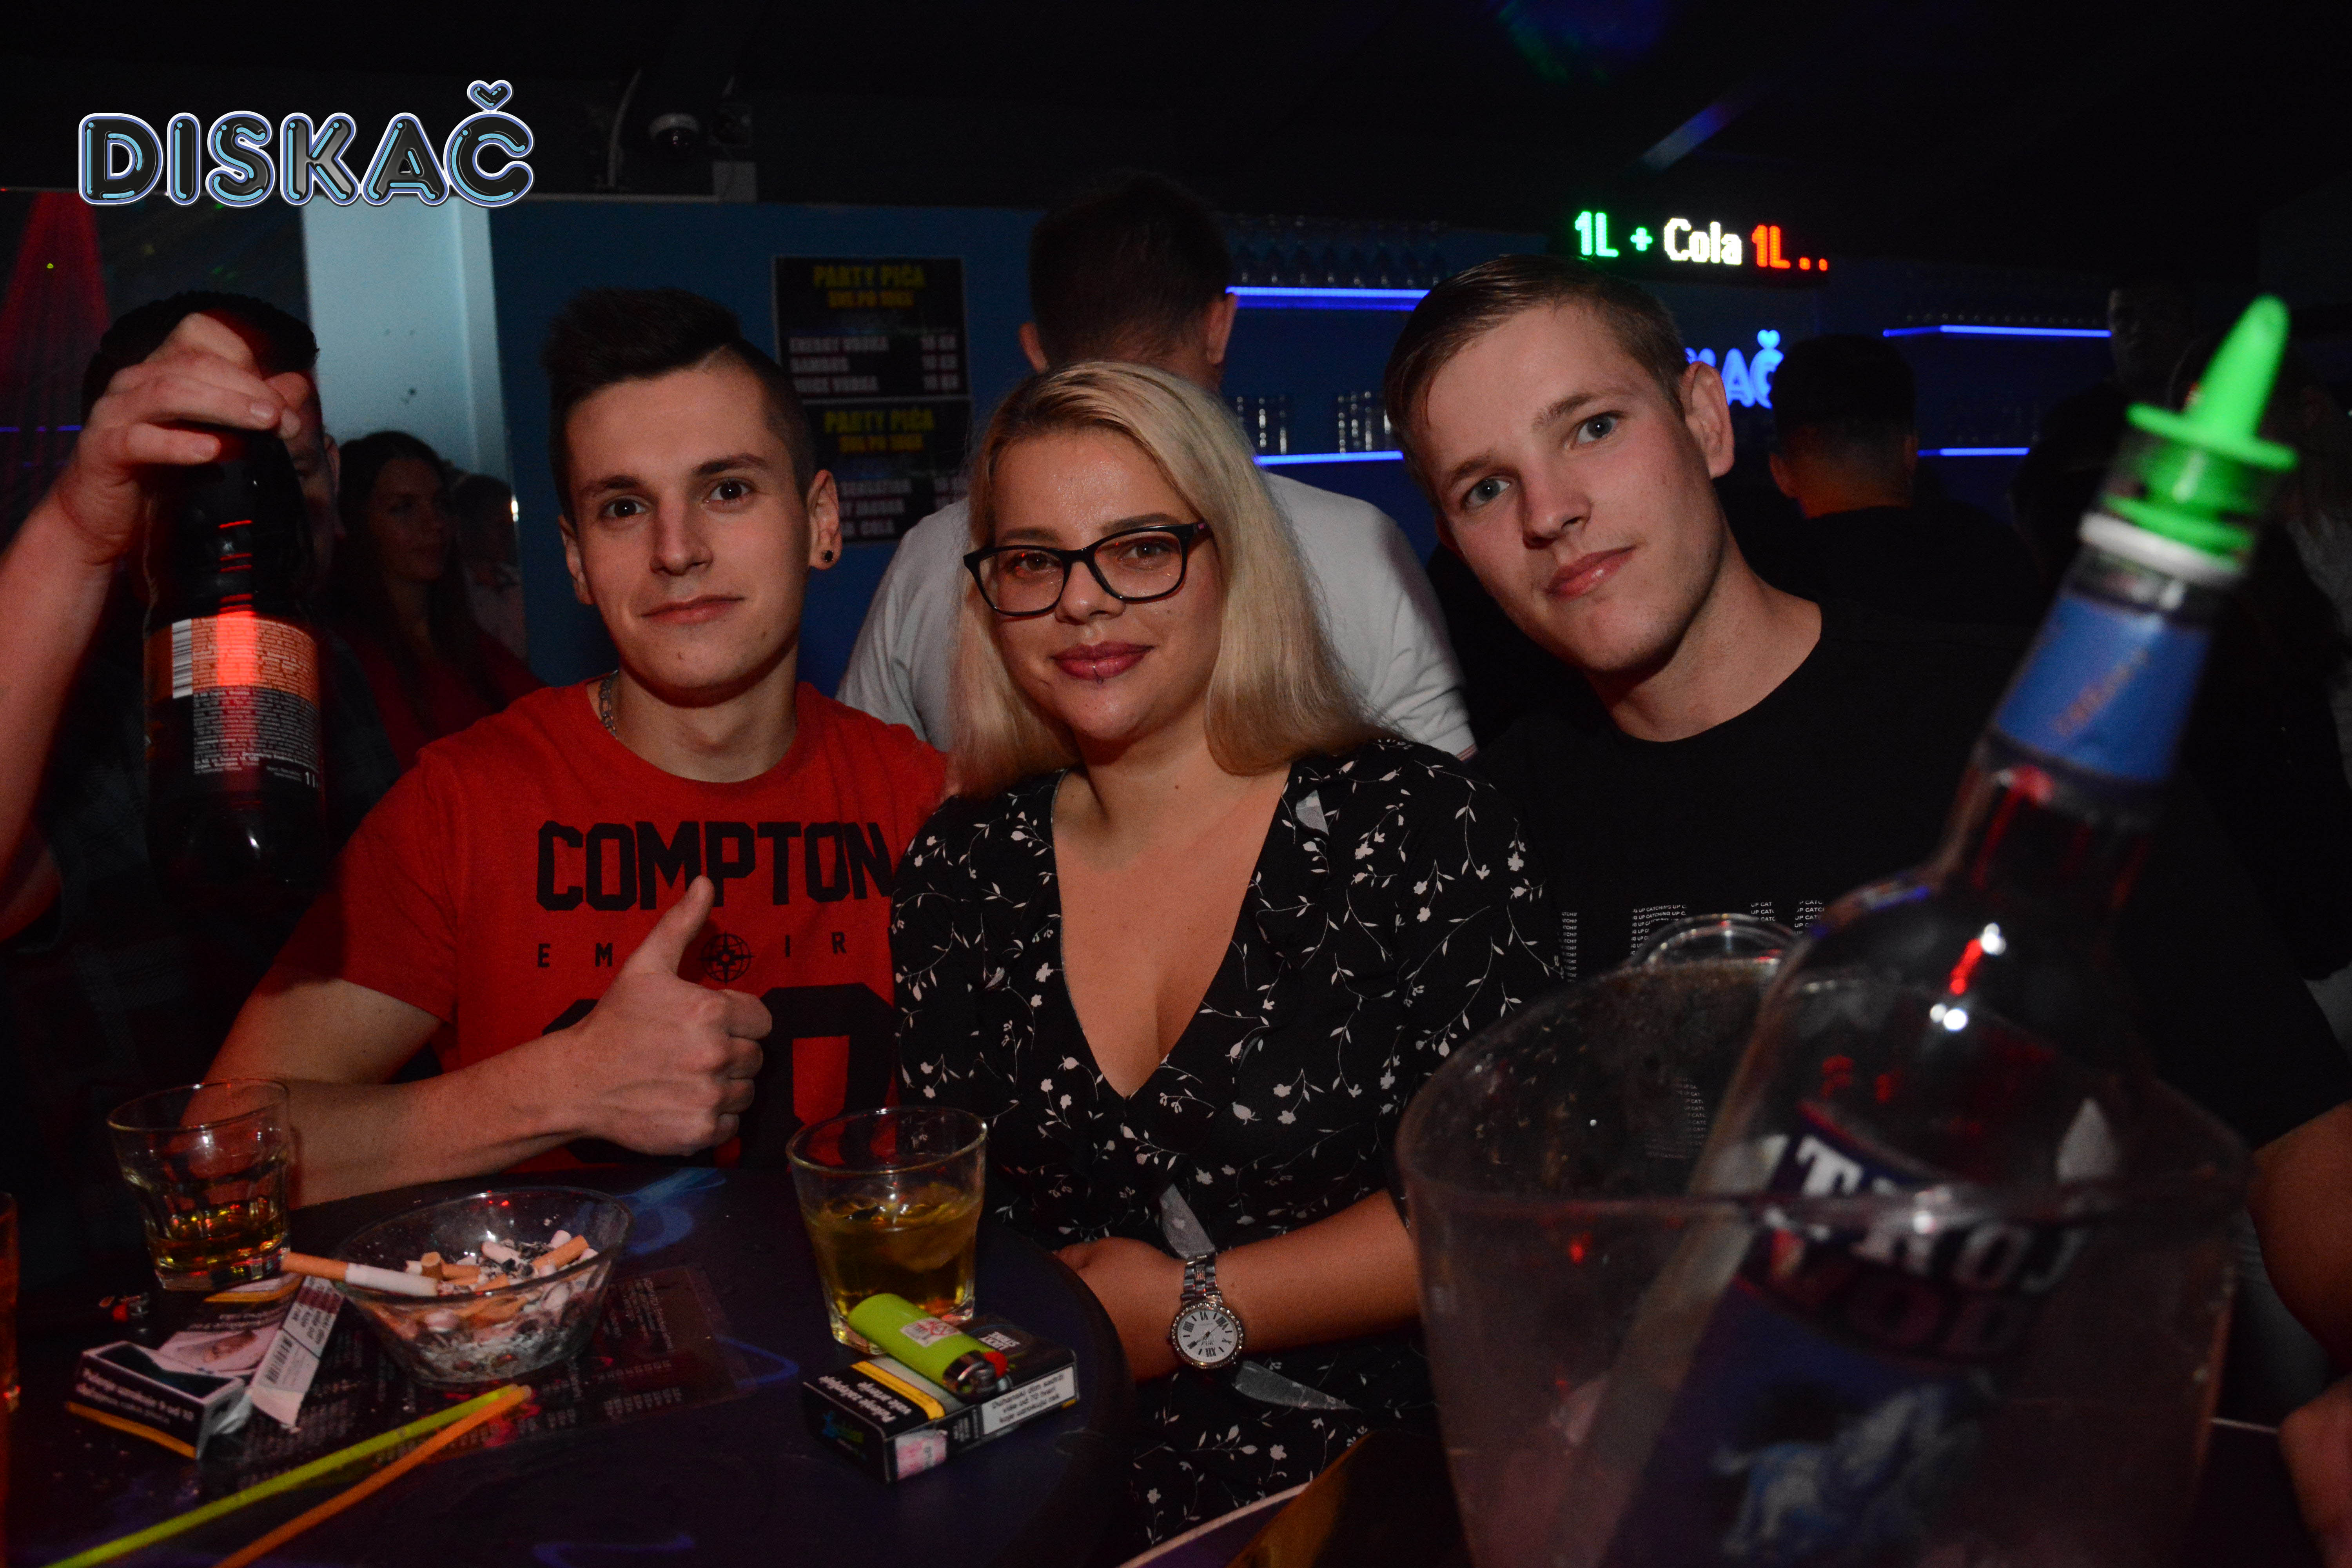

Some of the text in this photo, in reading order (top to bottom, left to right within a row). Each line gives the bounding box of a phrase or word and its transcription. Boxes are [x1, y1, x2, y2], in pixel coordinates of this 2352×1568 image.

[1575, 211, 1619, 257] 1L
[1664, 218, 1743, 265] Cola
[813, 266, 875, 288] PARTY
[824, 410, 885, 434] PARTY
[537, 820, 895, 911] COMPTON
